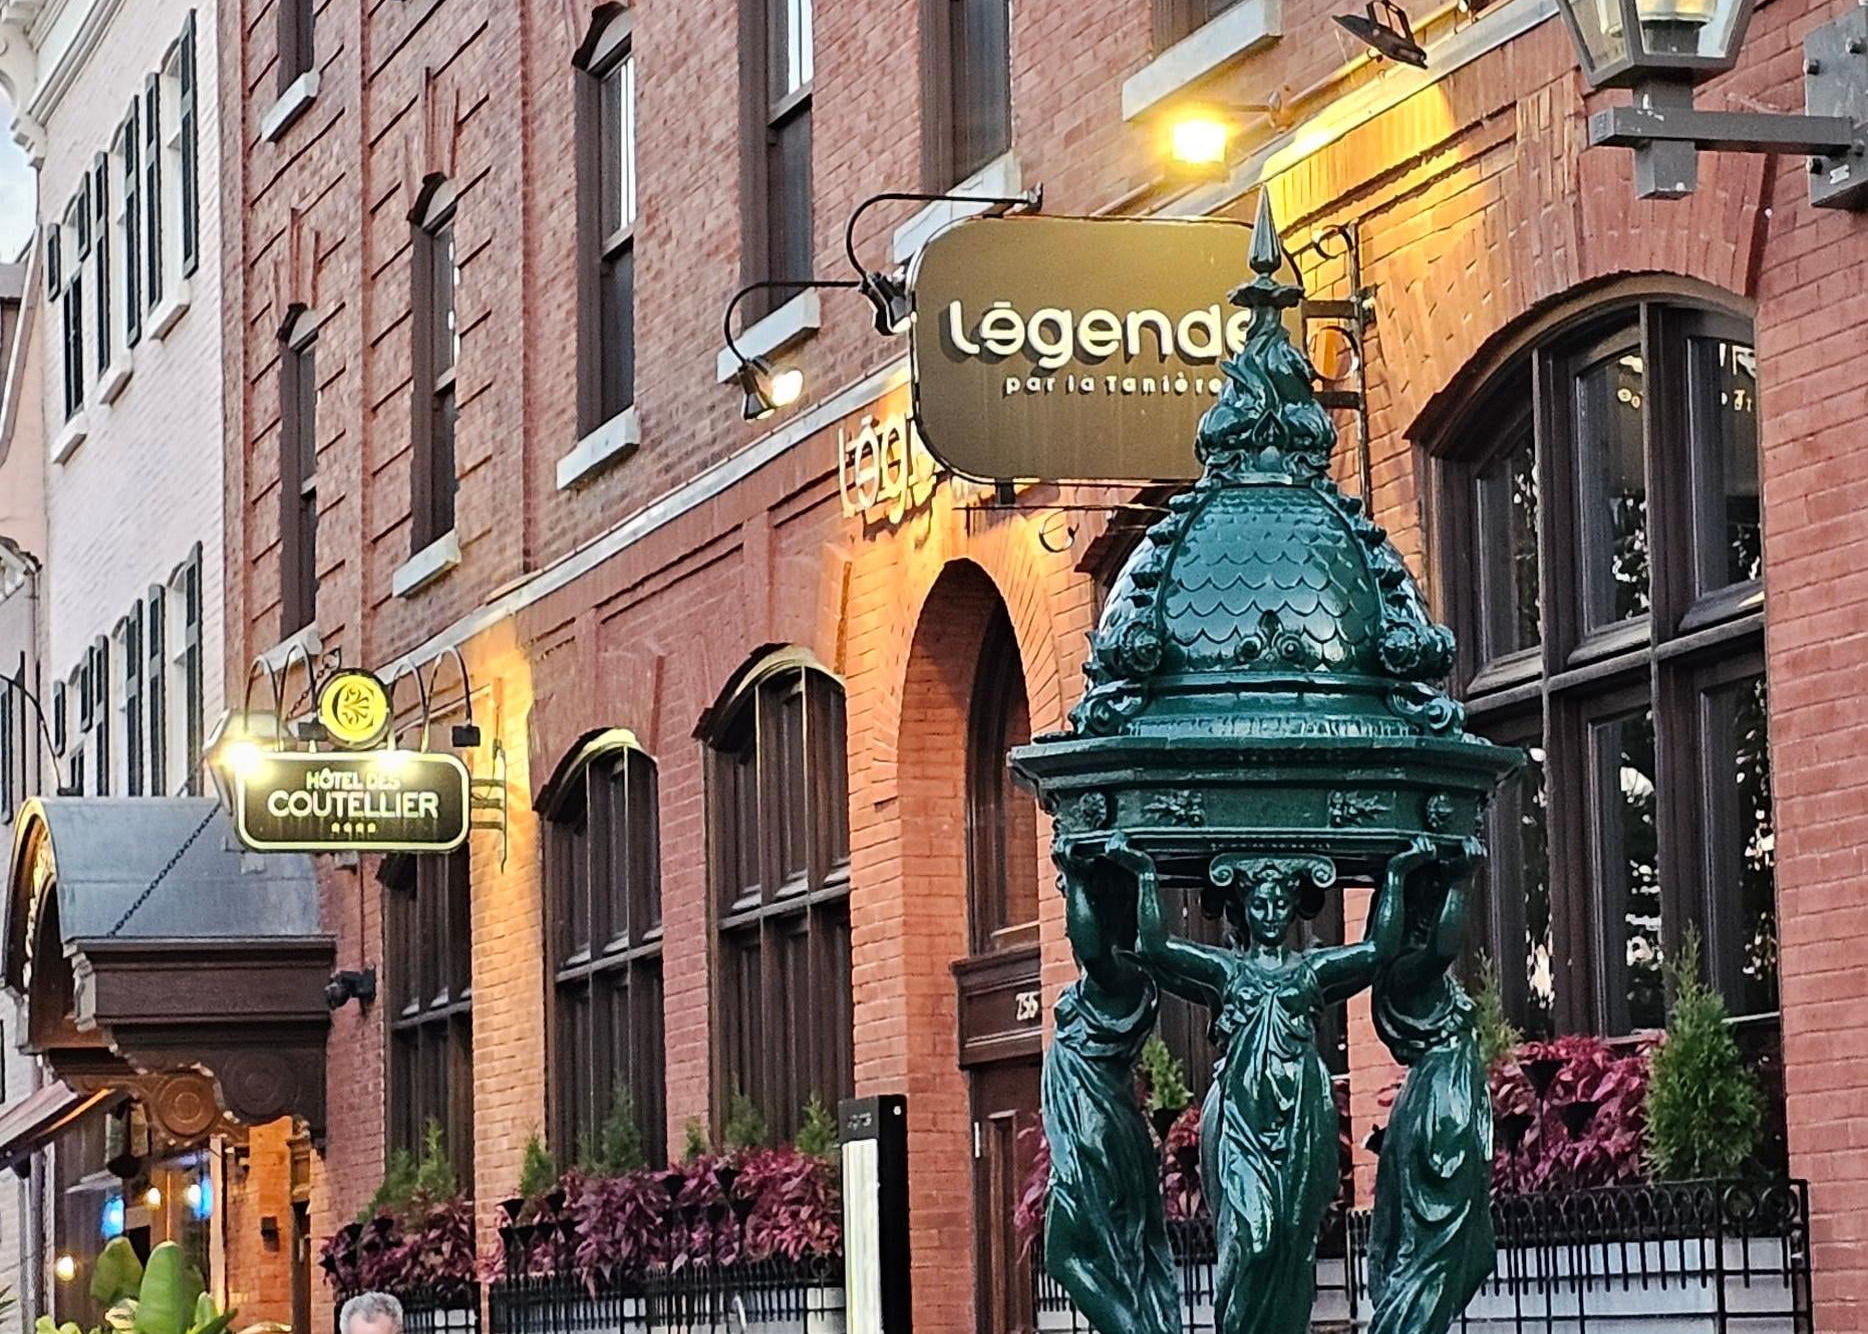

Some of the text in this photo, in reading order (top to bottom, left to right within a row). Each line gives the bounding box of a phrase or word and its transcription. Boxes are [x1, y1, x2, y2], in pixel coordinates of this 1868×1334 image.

[1006, 374, 1055, 395] par
[1068, 374, 1095, 393] la
[305, 767, 400, 791] HÔTEL DES
[267, 790, 440, 819] COUTELLIER
